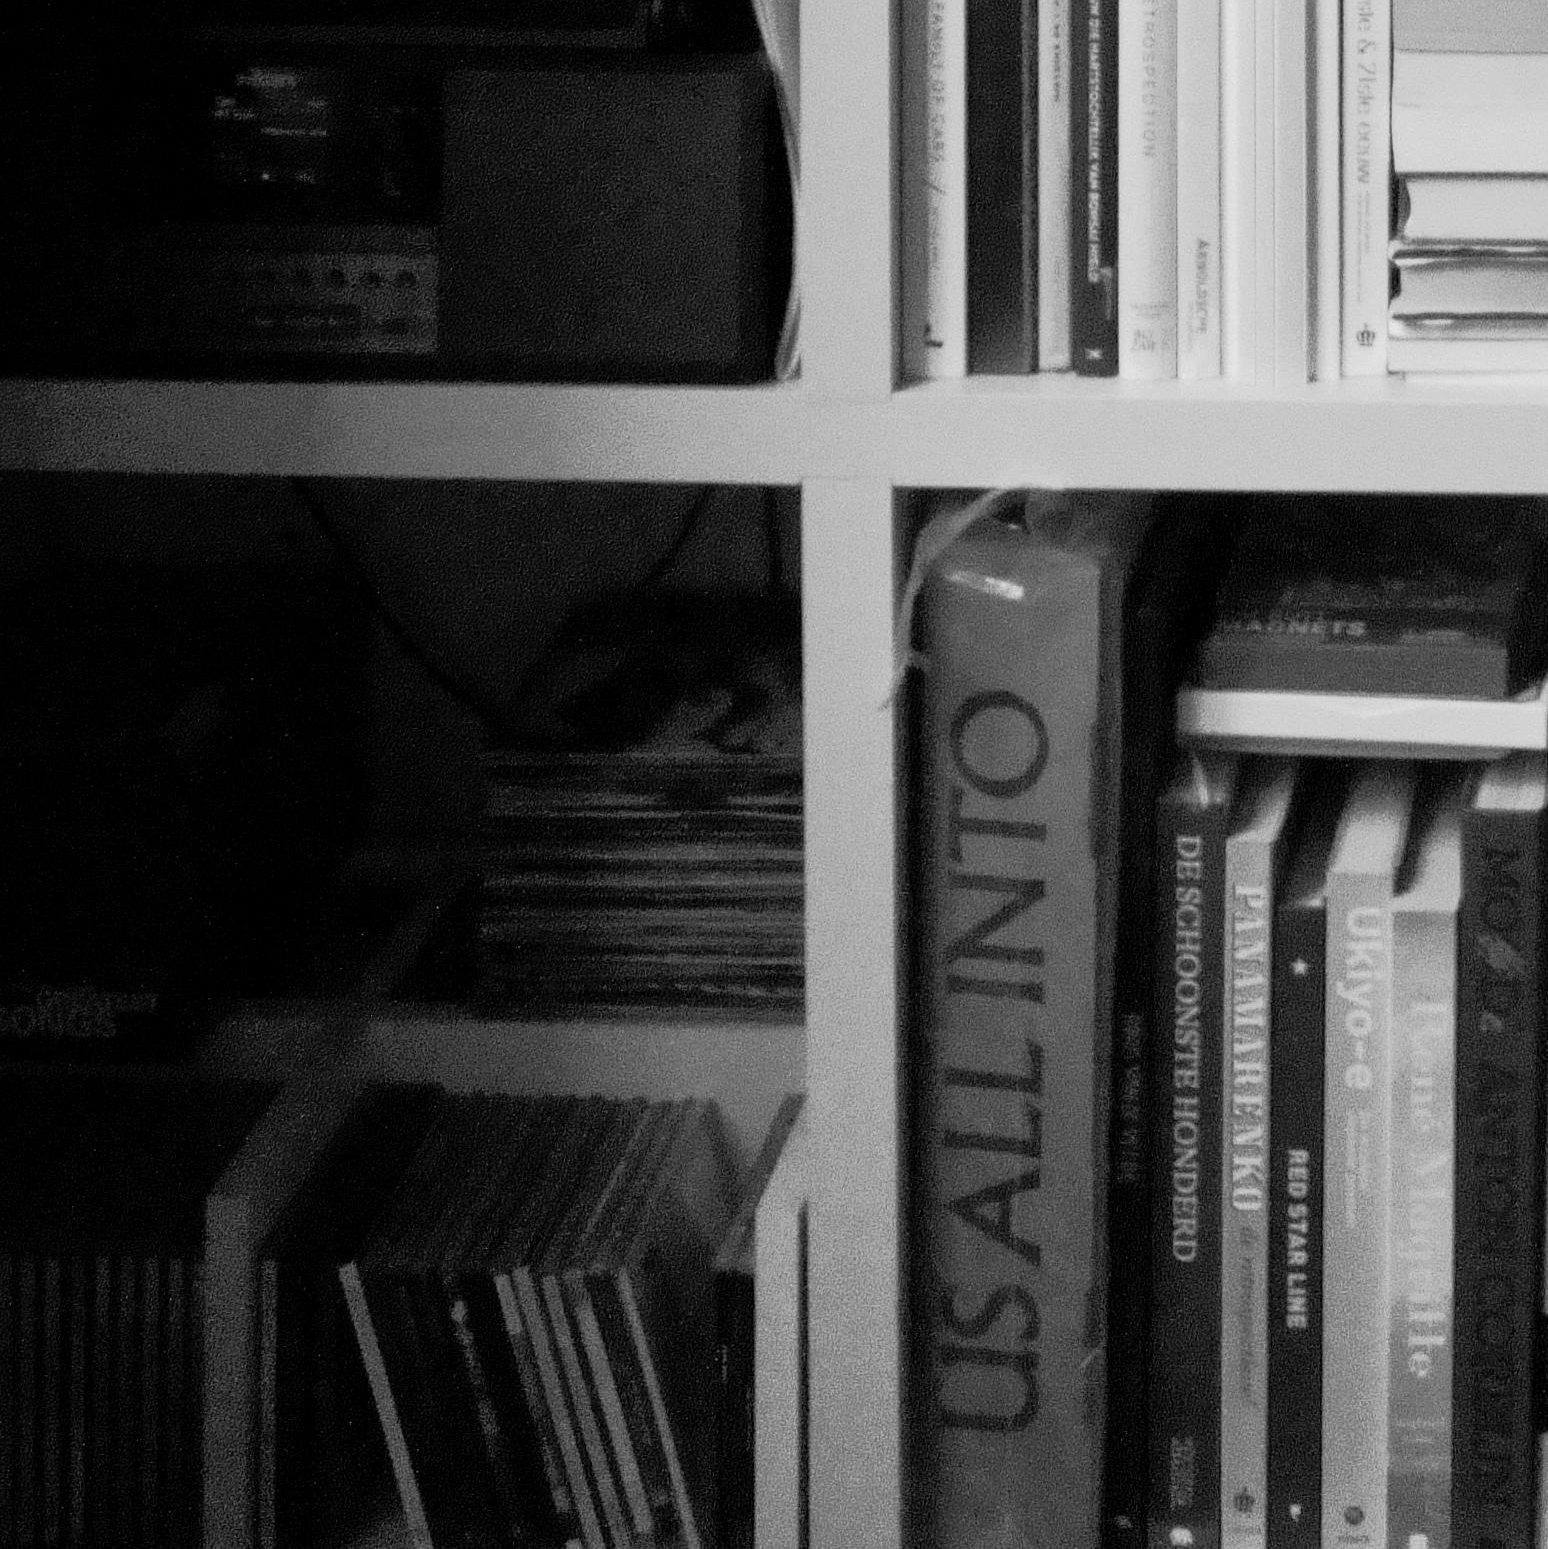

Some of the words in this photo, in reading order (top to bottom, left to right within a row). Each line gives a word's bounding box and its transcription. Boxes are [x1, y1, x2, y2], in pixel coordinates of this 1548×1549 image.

[1089, 14, 1102, 40] DIE
[1356, 37, 1378, 56] &
[1089, 163, 1102, 190] VAN
[1356, 120, 1378, 185] eeuw
[941, 691, 1049, 1005] INTO
[1172, 834, 1202, 880] DE
[1171, 885, 1202, 1089] SCHOONSTE
[1336, 905, 1386, 1091] Ukiyo-e
[1231, 883, 1269, 1212] PANAMARENKO
[941, 1040, 1043, 1267] ALL
[1171, 1095, 1201, 1262] HONDERD
[1286, 1147, 1309, 1201] RED
[1286, 1203, 1309, 1267] STAR
[1286, 1271, 1309, 1328] LINE
[941, 1286, 1041, 1435] US
